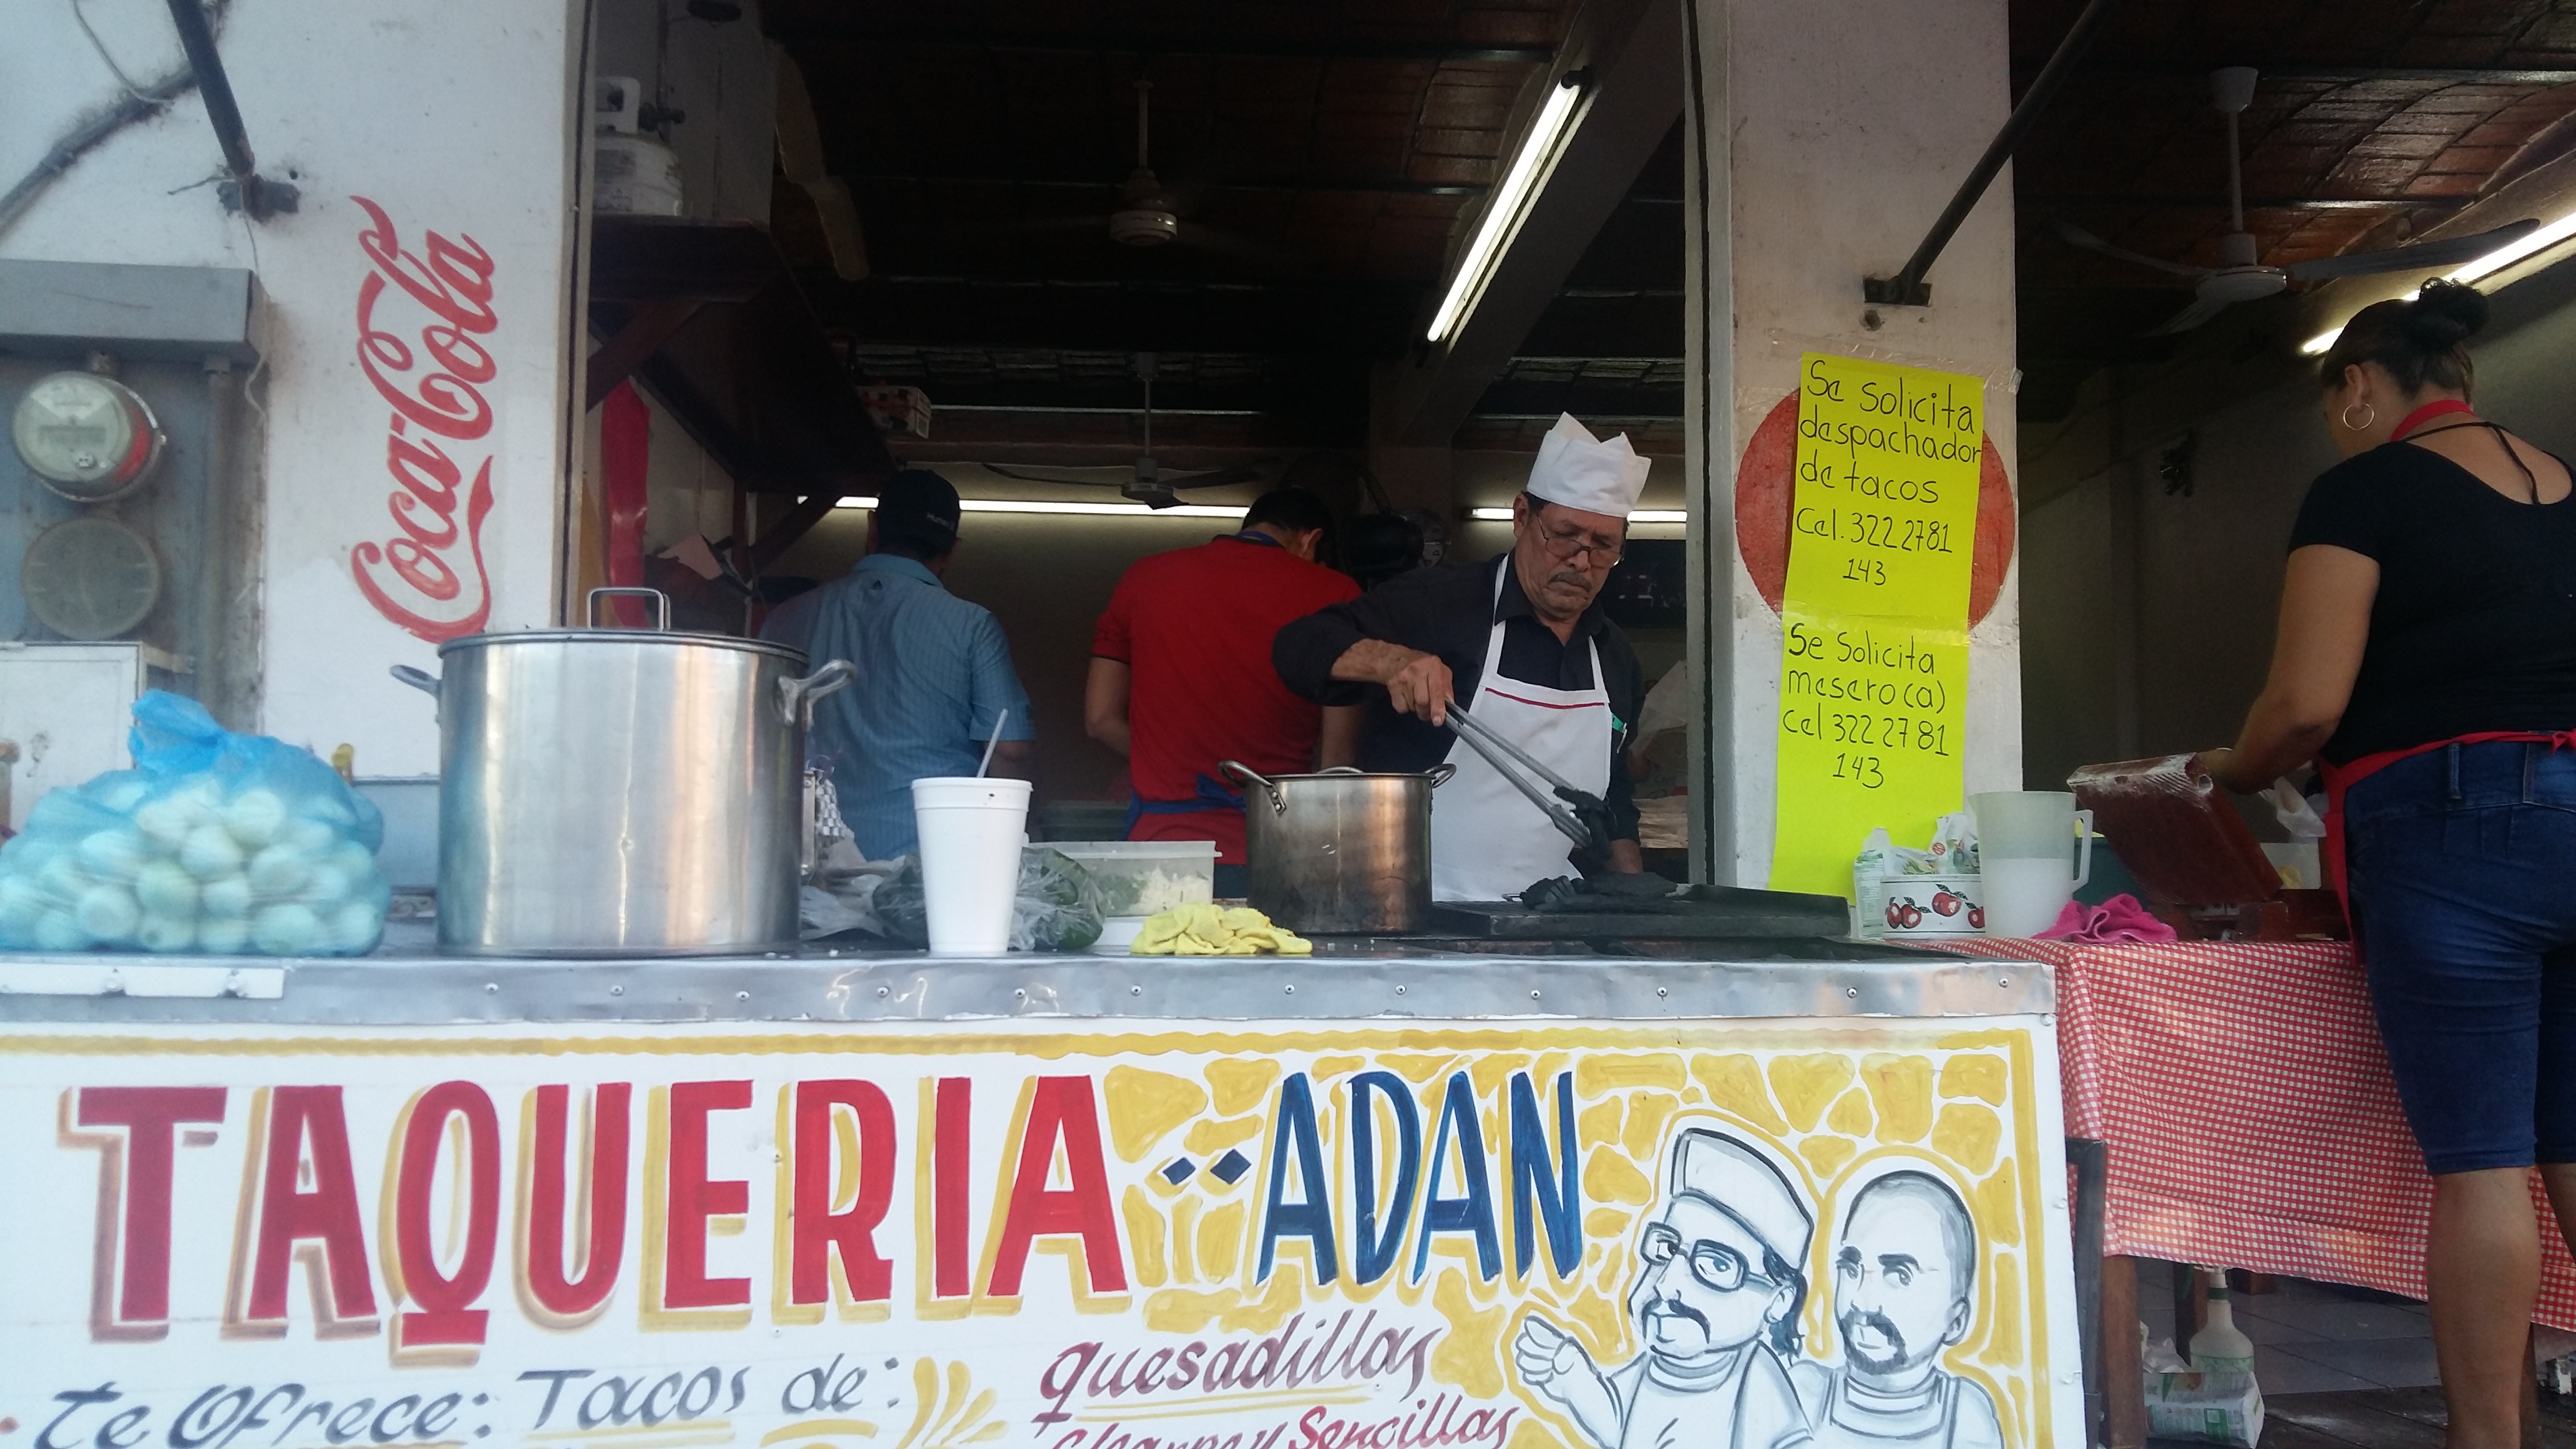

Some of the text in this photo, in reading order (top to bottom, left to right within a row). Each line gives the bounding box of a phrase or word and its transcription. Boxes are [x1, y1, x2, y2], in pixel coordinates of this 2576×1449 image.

[1807, 359, 1844, 402] Se
[349, 195, 499, 645] Coca-Cola
[1799, 404, 1982, 464] despachador
[1800, 449, 1939, 504] de tacos
[1842, 558, 1886, 585] 143
[1788, 623, 1823, 660] Se
[1832, 753, 1884, 789] 143
[76, 1070, 1584, 1347] TAQUERIA ADAN
[515, 1365, 751, 1431] Tacos
